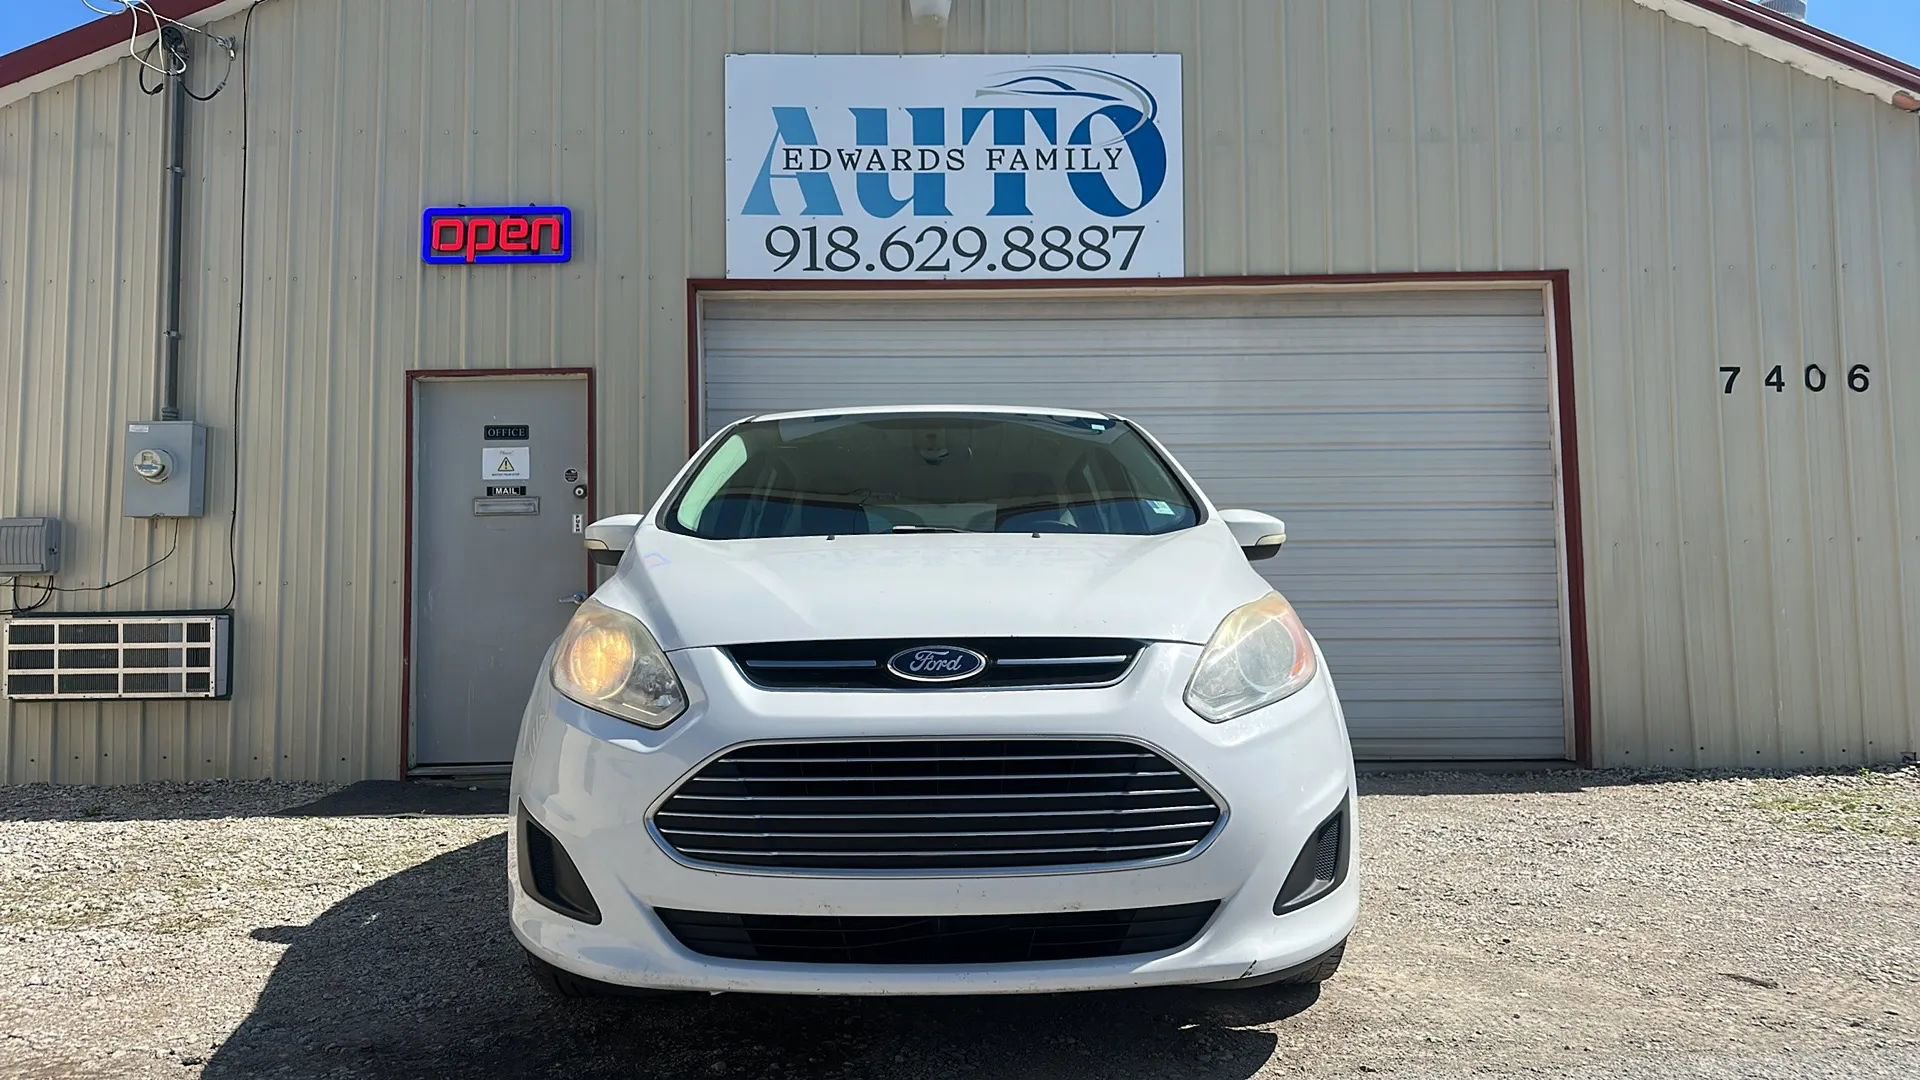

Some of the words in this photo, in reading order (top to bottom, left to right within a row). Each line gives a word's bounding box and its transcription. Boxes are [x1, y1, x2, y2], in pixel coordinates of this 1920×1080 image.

[740, 105, 1167, 218] AUTO
[782, 148, 966, 171] EDWARDS
[985, 147, 1123, 171] FAMILY
[432, 217, 561, 263] open
[764, 225, 1146, 273] 918.629.8887
[1719, 364, 1871, 394] 7406
[487, 428, 526, 437] OFFICE
[495, 487, 518, 496] MAIL
[909, 650, 964, 672] Ford
